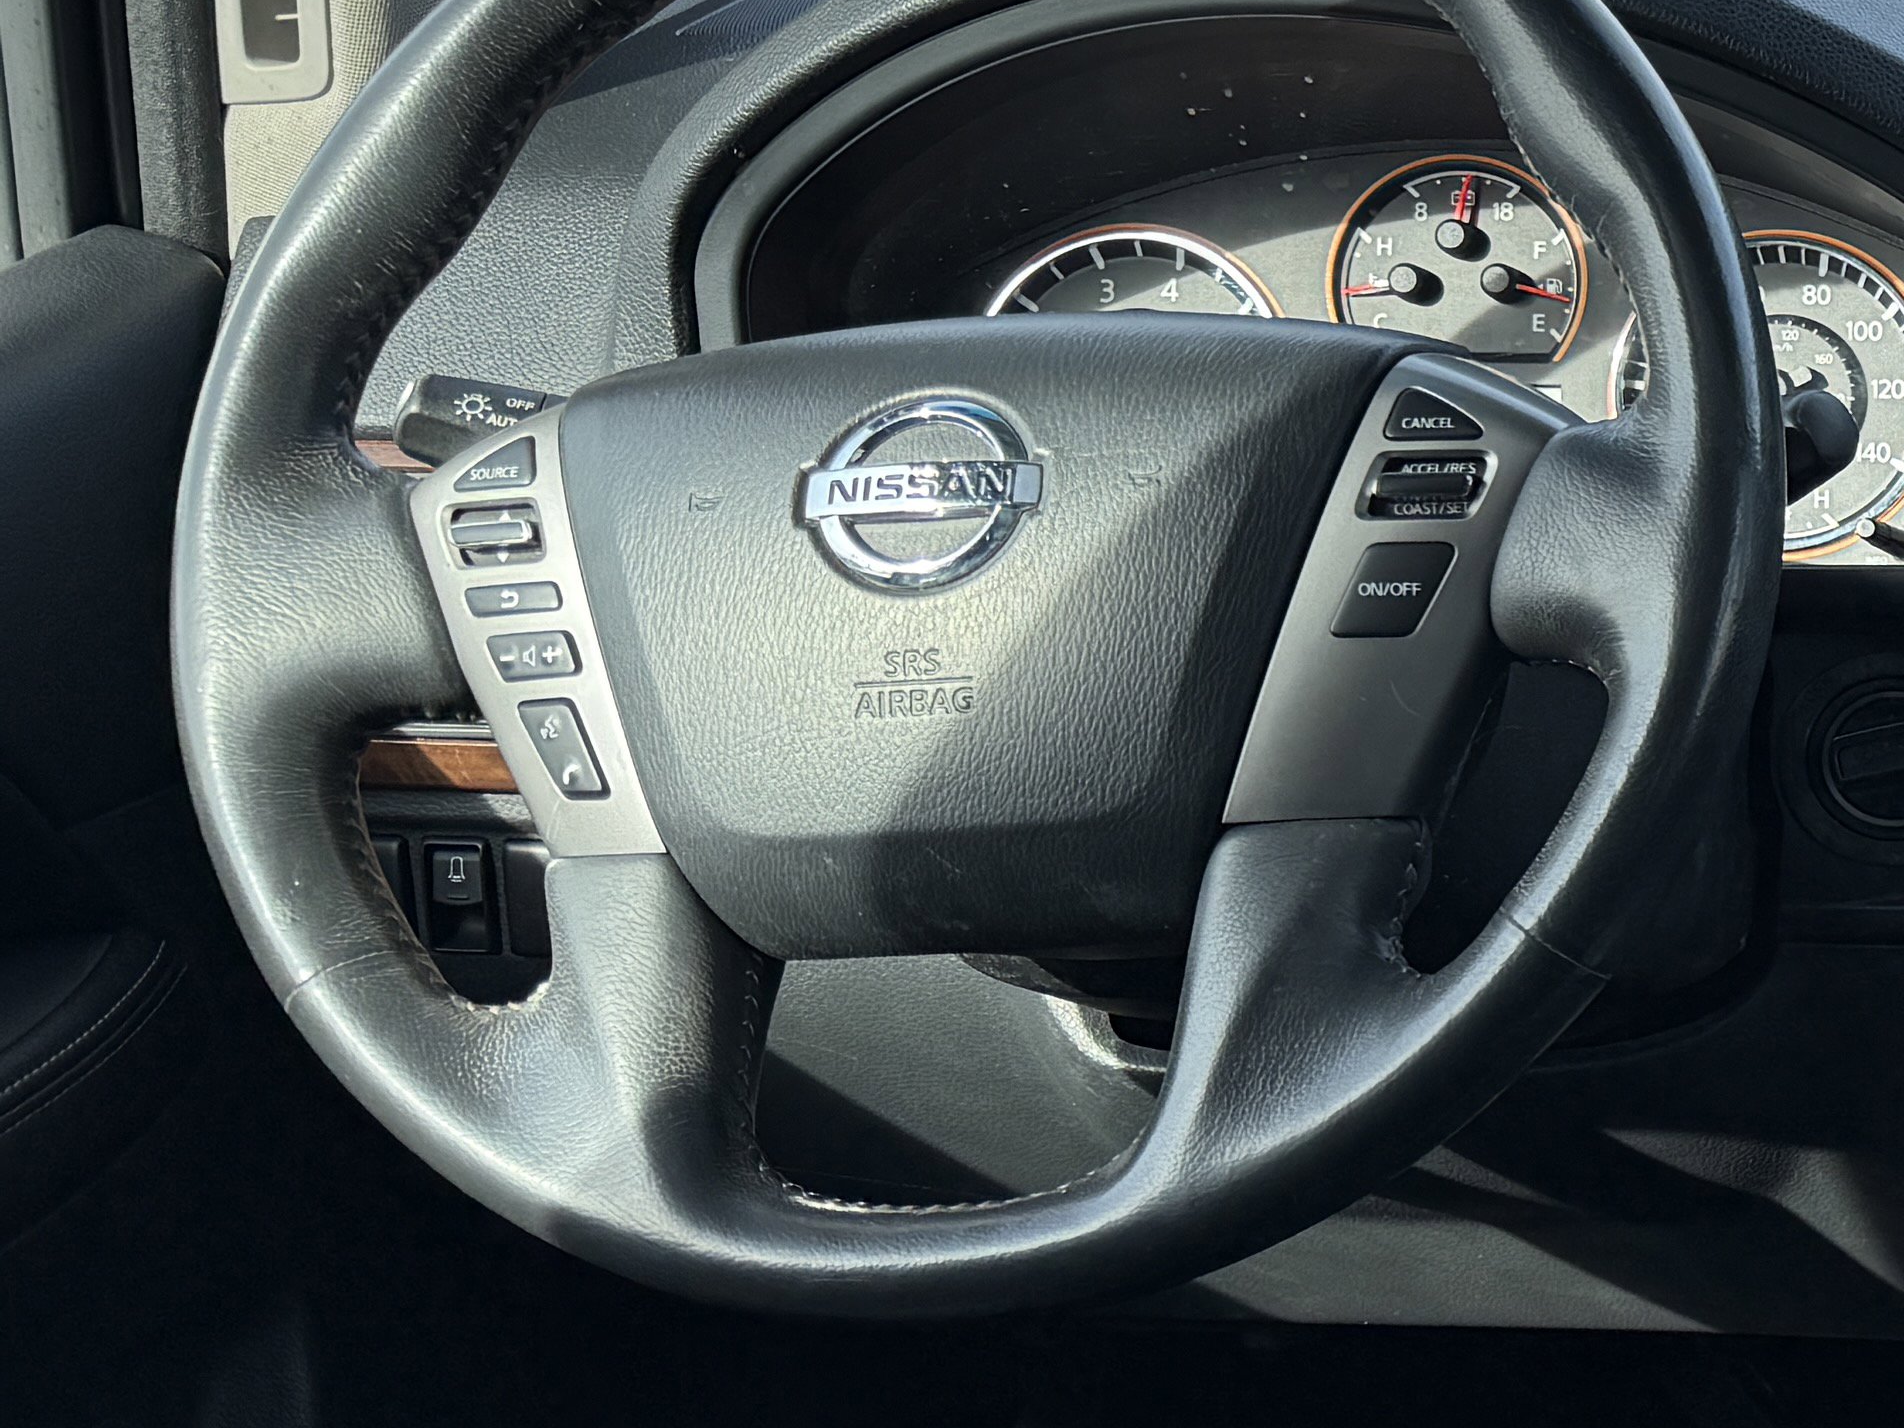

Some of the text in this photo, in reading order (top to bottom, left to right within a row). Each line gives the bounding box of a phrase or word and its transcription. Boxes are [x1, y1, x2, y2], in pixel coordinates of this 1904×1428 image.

[1414, 202, 1428, 222] 8
[1493, 202, 1515, 222] 18
[1376, 237, 1393, 256] H
[1533, 241, 1547, 260] F
[1099, 279, 1115, 303] 3
[1160, 278, 1179, 303] 4
[1801, 283, 1832, 306] 80
[1532, 313, 1546, 332] E
[1846, 320, 1883, 341] 100
[1781, 329, 1800, 341] 120
[506, 398, 536, 411] OFF
[486, 413, 519, 428] AUT
[1401, 417, 1455, 429] CANCEL
[1856, 443, 1892, 463] 140
[470, 466, 519, 481] SOURCE
[827, 465, 1016, 506] NISSAN
[1813, 489, 1830, 509] H
[1358, 582, 1422, 597] ON/OFF
[883, 647, 941, 678] SRS
[853, 685, 976, 720] AIRBAG
